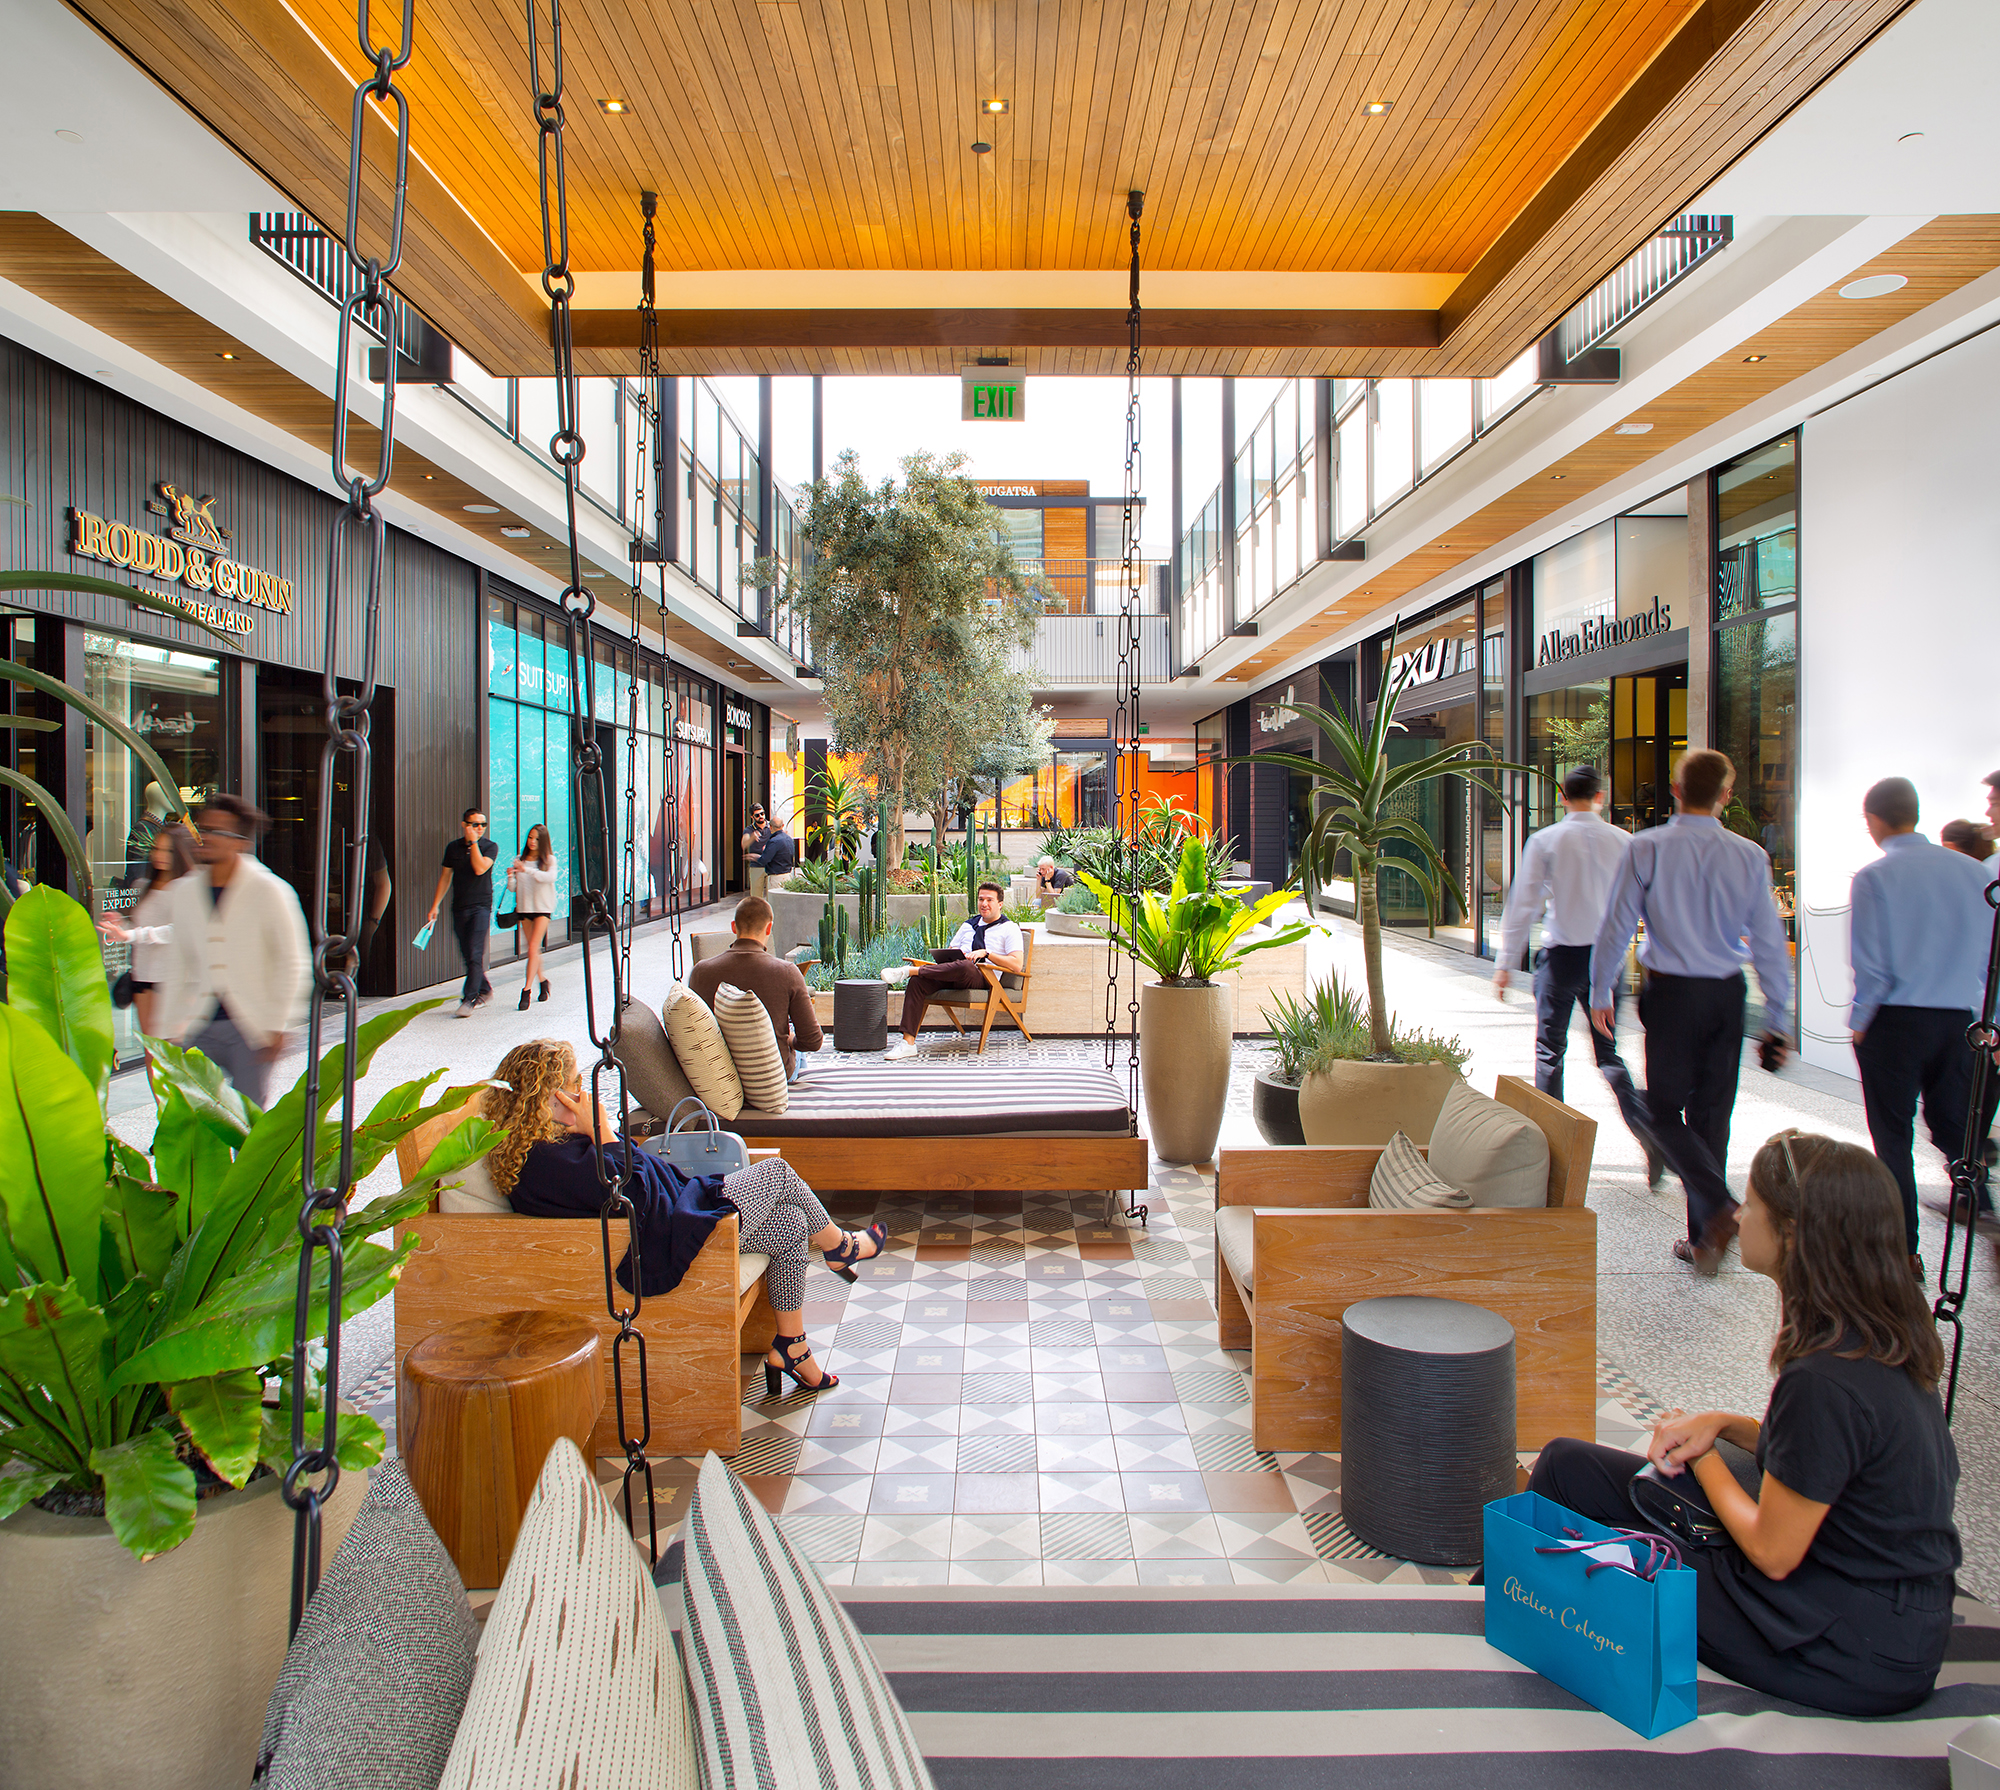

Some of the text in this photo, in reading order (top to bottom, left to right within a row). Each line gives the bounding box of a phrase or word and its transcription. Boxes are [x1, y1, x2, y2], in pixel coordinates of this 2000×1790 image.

[974, 386, 1017, 418] EXIT
[1538, 595, 1672, 667] Allen Edmonds
[726, 704, 752, 730] BONOBOS
[676, 720, 712, 747] SUITSUPPLY
[102, 897, 140, 910] EXPLOR
[105, 888, 142, 898] THE MODE
[1503, 1576, 1626, 1655] Atelier Cologne
